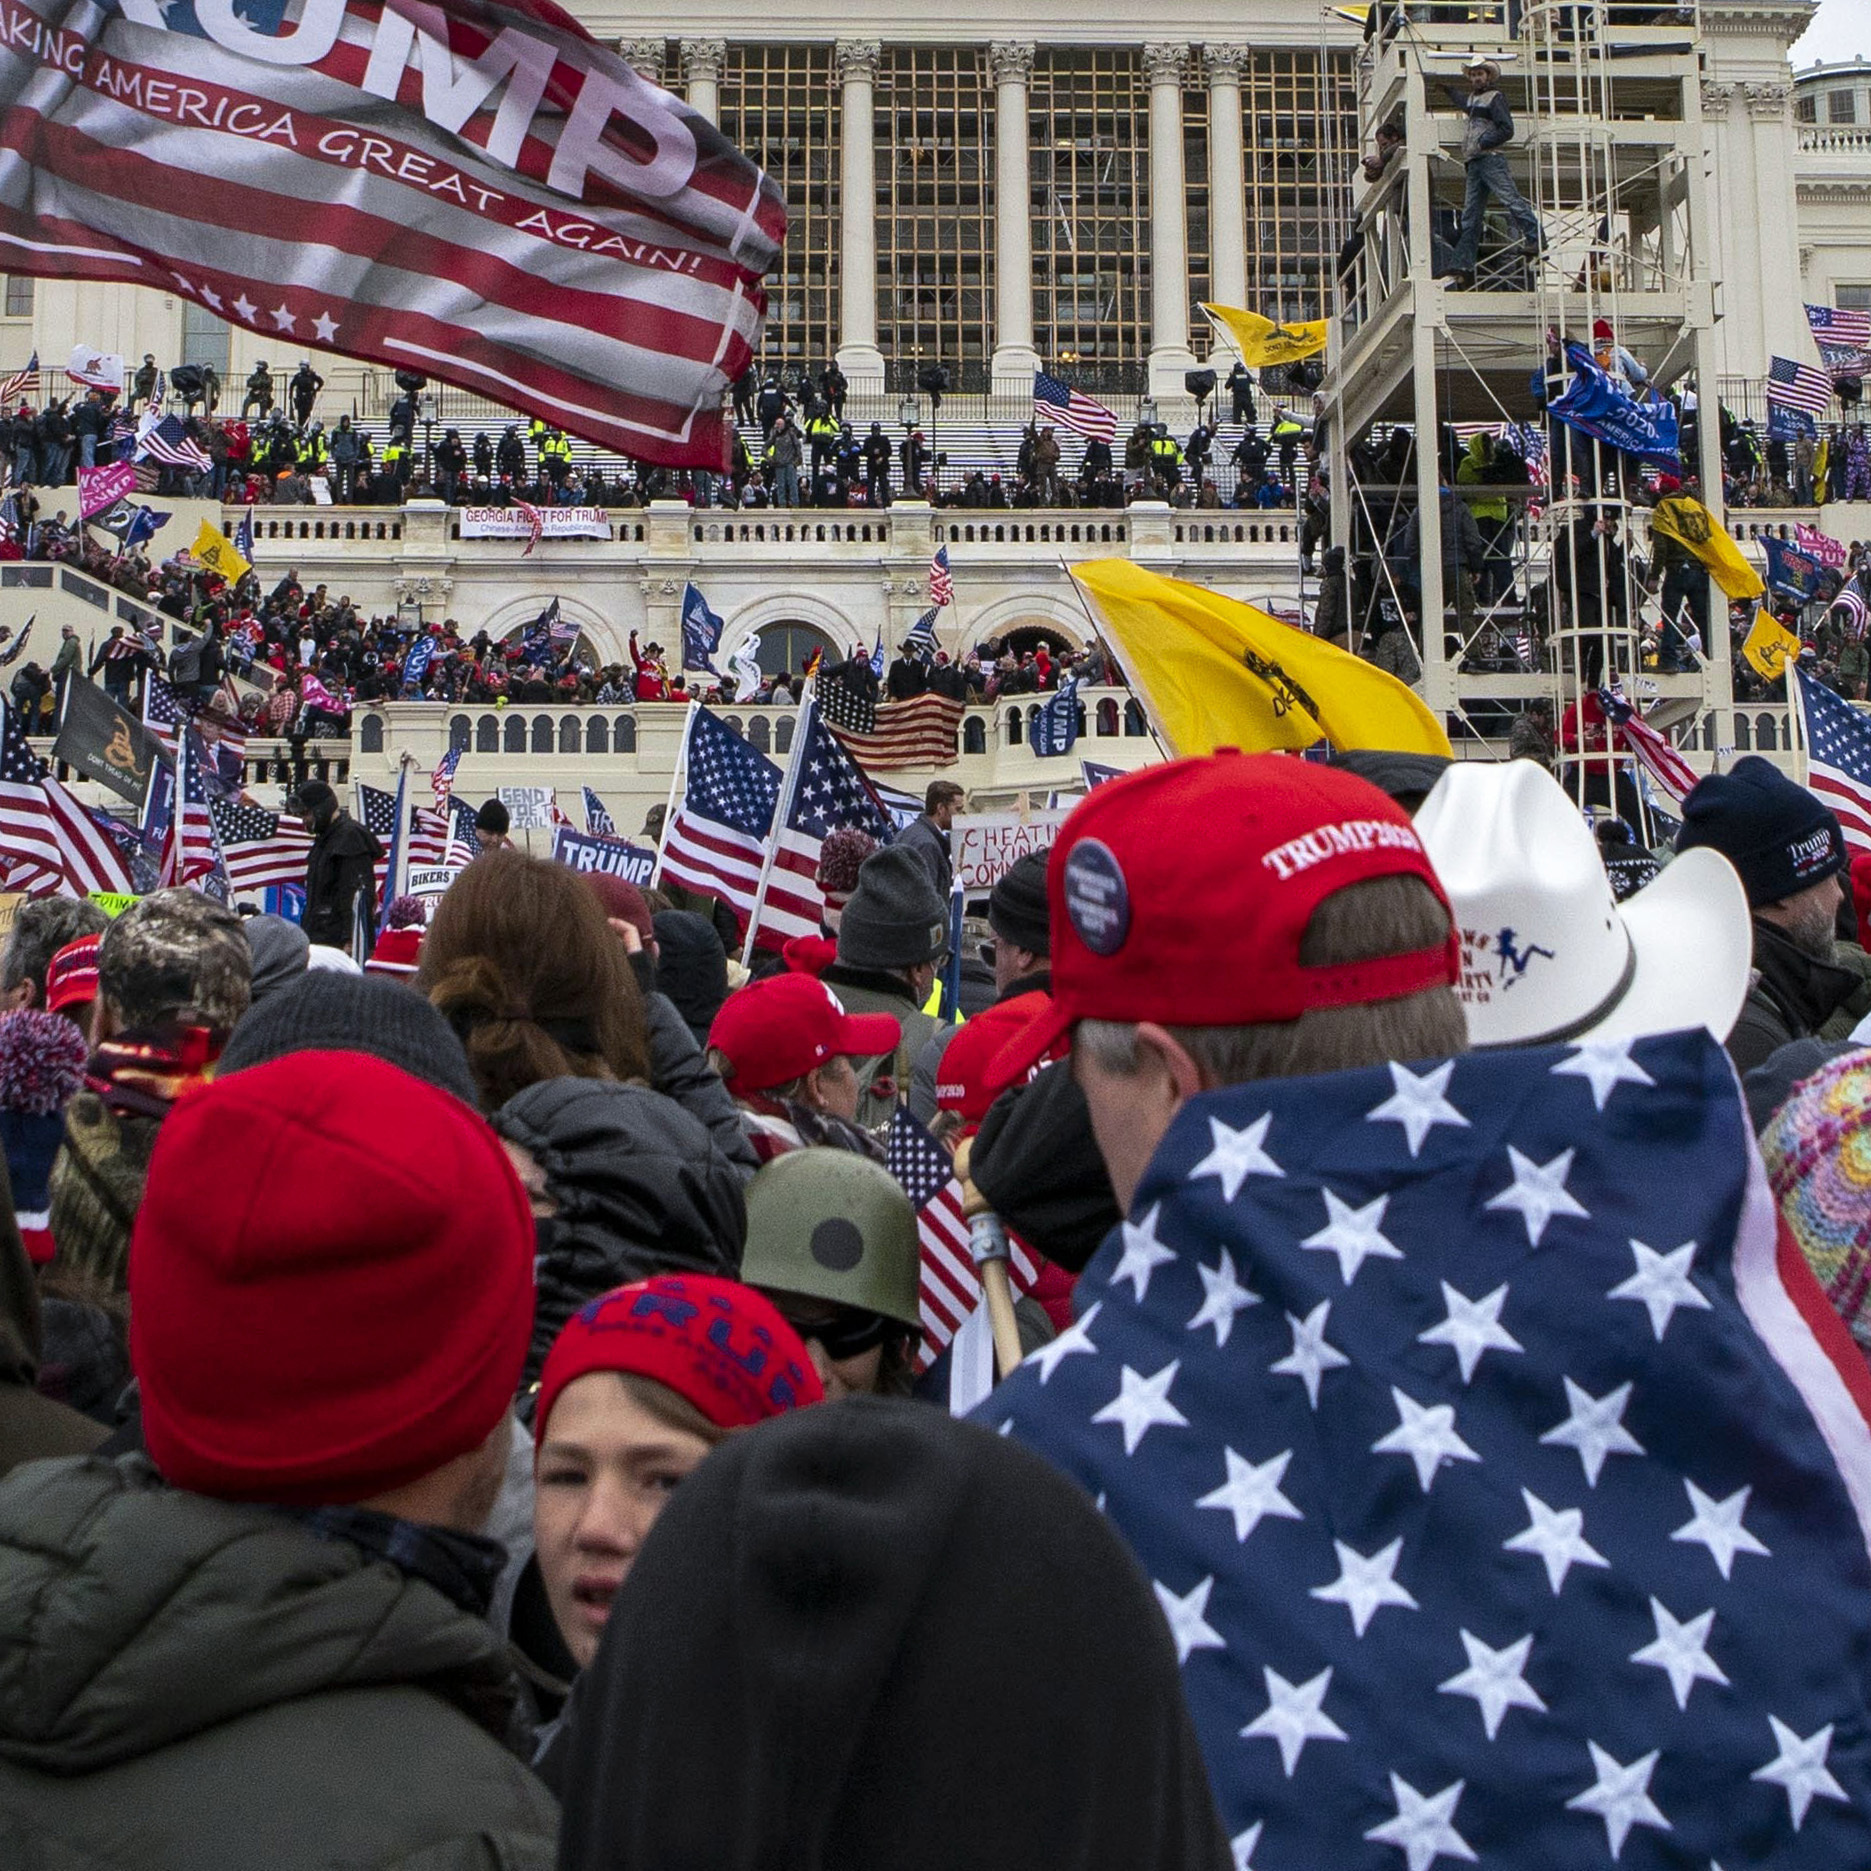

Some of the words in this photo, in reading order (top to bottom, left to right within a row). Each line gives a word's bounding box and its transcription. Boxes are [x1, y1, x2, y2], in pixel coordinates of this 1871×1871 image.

[94, 57, 299, 147] AMERICA
[318, 129, 505, 211] GREAT
[515, 211, 702, 274] AGAIN!
[466, 509, 513, 523] GEORGIA
[516, 510, 547, 523] FIGT
[550, 509, 572, 523] FOR
[502, 788, 545, 805] SEND
[1787, 829, 1831, 858] Trump
[562, 839, 655, 886] TRUMP
[411, 871, 449, 887] BIKERS
